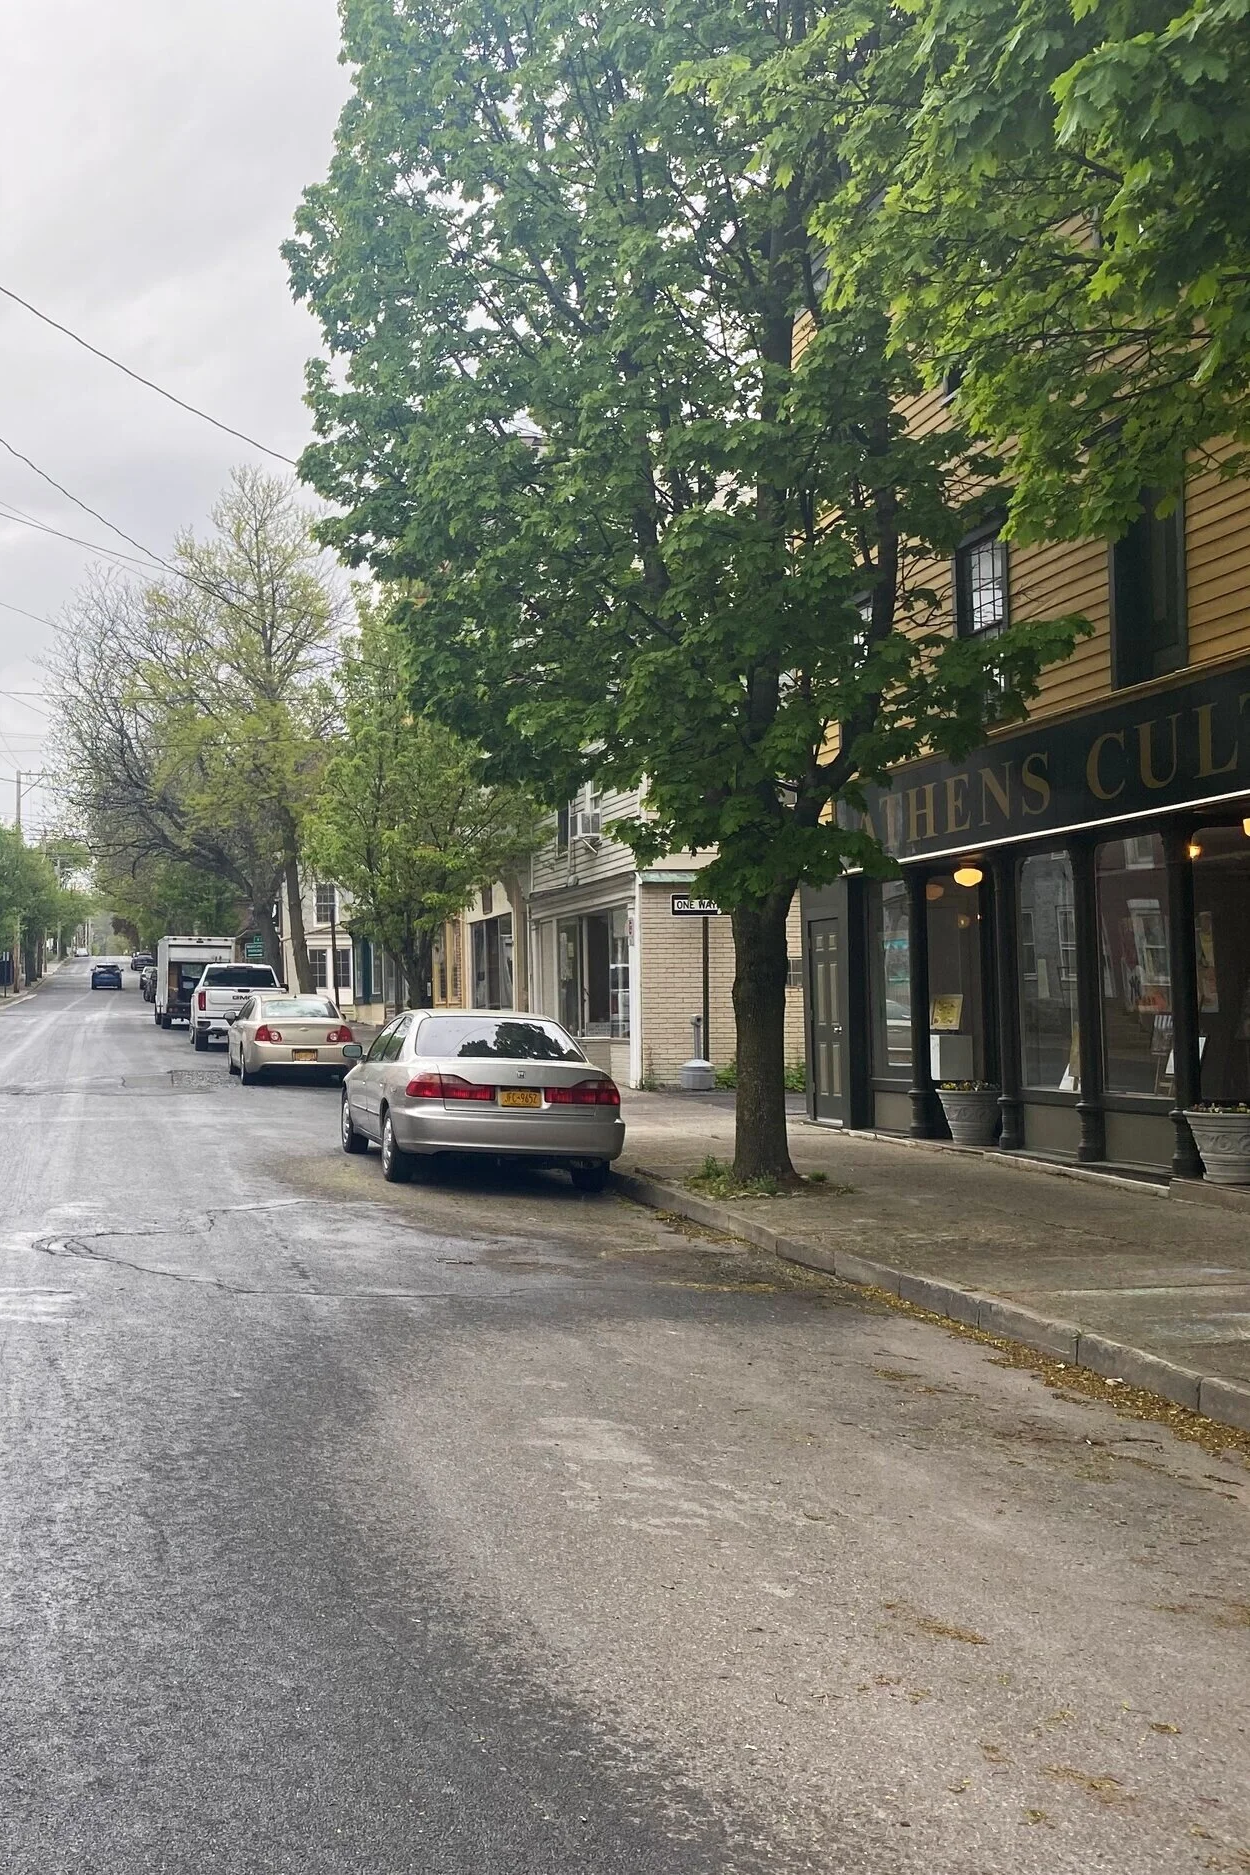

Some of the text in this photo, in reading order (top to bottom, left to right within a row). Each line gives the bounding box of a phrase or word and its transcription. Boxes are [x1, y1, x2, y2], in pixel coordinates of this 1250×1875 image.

[1085, 692, 1250, 800] CUL
[676, 900, 718, 909] ONE WAY
